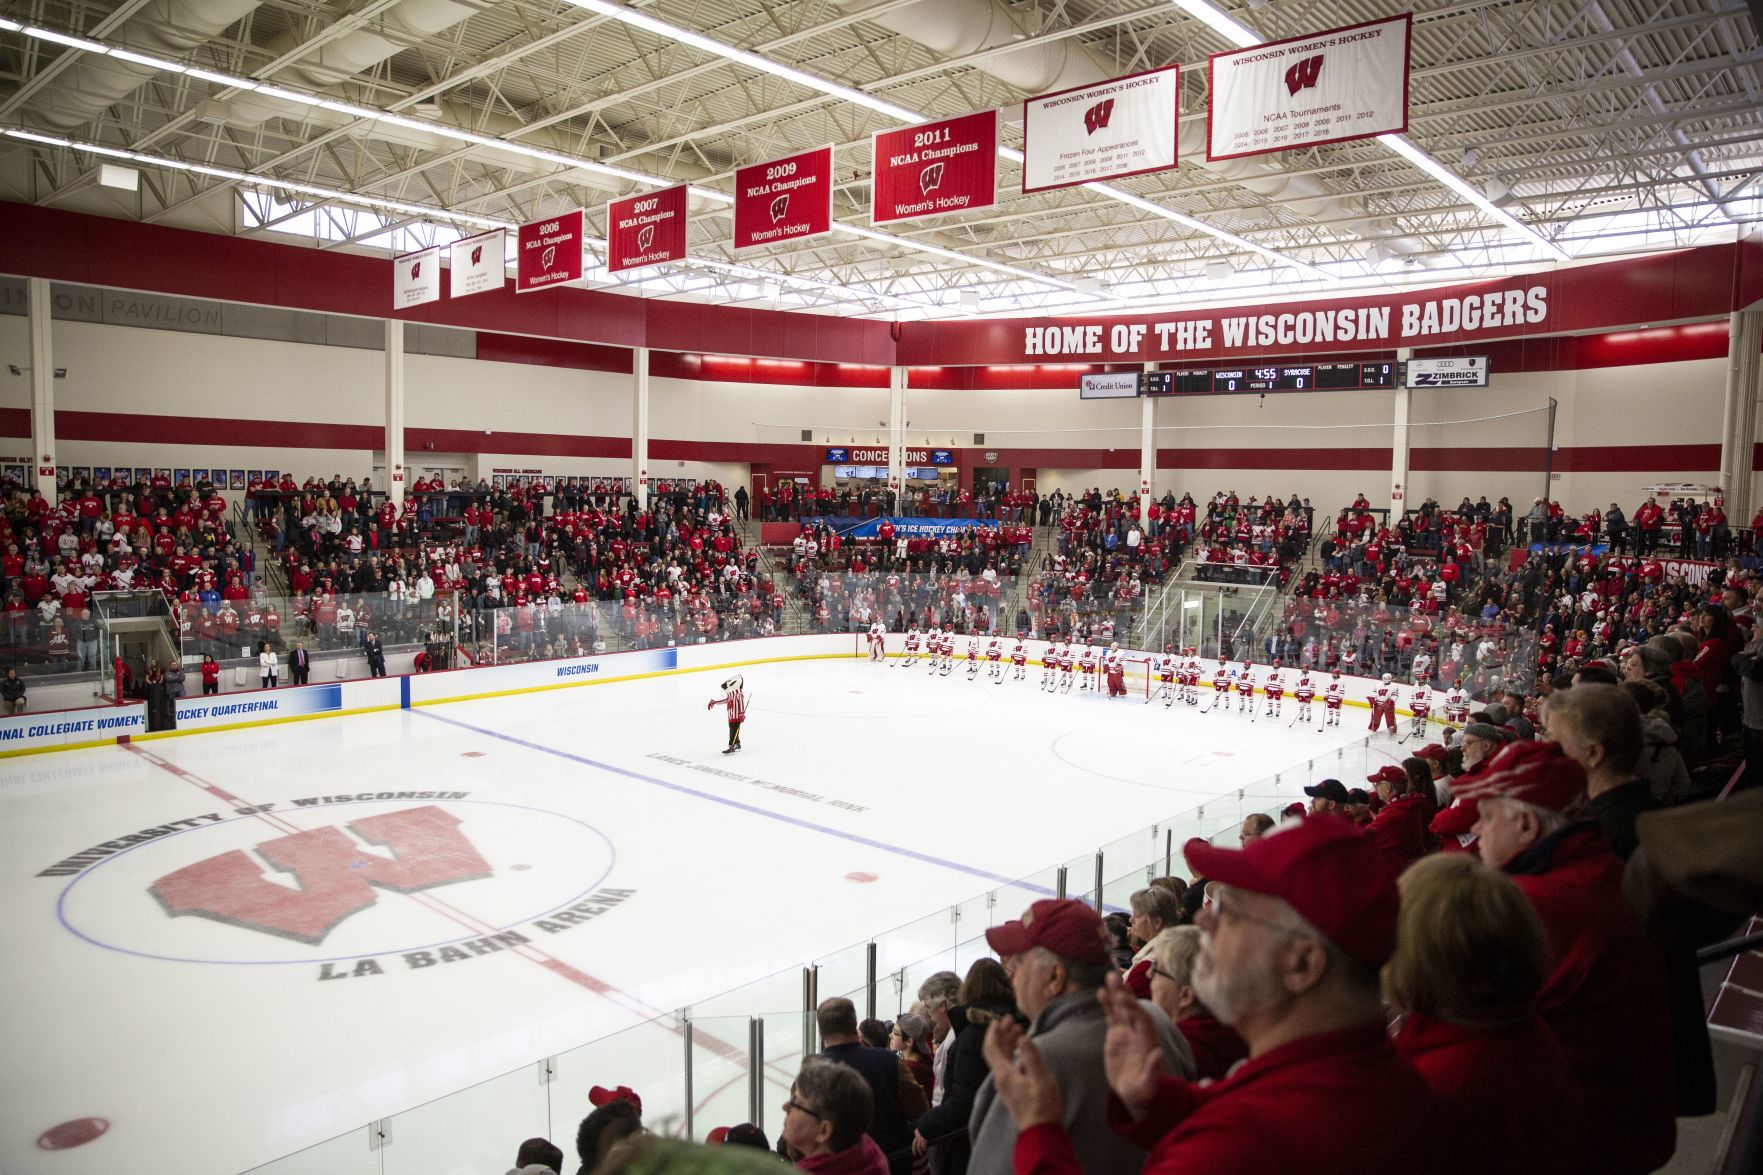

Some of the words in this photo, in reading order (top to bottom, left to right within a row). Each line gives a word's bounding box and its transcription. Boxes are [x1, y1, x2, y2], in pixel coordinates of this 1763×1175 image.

[1232, 48, 1286, 67] WISCONSIN
[1287, 38, 1337, 55] WOMEN'S
[1338, 28, 1383, 45] HOCKEY
[1042, 93, 1085, 109] WISCONSIN
[1086, 83, 1124, 99] WOMEN'S
[1125, 75, 1160, 90] HOCKEY
[1263, 111, 1287, 123] NCAA
[1289, 103, 1342, 119] Tournaments
[1253, 127, 1269, 136] 2006
[1273, 124, 1289, 133] 2007
[1293, 121, 1310, 130] 2008
[1314, 118, 1331, 127] 2009
[1335, 114, 1352, 123] 2011
[1356, 111, 1374, 120] 2012
[914, 127, 951, 148] 2011
[1293, 131, 1309, 140] 2017
[1313, 128, 1330, 138] 2018
[889, 152, 920, 167] NCAA
[921, 142, 979, 161] Champions
[1059, 149, 1081, 160] Frozen
[1081, 147, 1096, 157] Four
[1097, 139, 1139, 155] Appearances
[1132, 149, 1146, 158] 2012
[766, 162, 797, 180] 2009
[746, 184, 771, 198] NCAA
[771, 175, 817, 192] Champions
[633, 198, 659, 214] 2007
[895, 200, 934, 215] Women's
[936, 195, 970, 208] Hockey
[539, 221, 560, 236] 2006
[619, 217, 638, 230] NCAA
[638, 210, 675, 223] Champions
[526, 239, 542, 250] NCAA
[543, 232, 573, 246] Champions
[751, 227, 783, 242] Women's
[783, 223, 811, 236] Hockey
[622, 254, 648, 267] Women's
[648, 250, 670, 261] Hockey
[529, 273, 551, 285] Women's
[551, 270, 569, 280] Hockey
[111, 299, 219, 326] PAVILION
[1025, 325, 1103, 355] HOME
[1110, 324, 1147, 353] OF
[1154, 319, 1213, 351] THE
[1221, 306, 1391, 348] WISCONSIN
[1401, 286, 1547, 338] BADGERS
[1215, 371, 1243, 379] WISCONSIN
[1255, 368, 1277, 379] 4:55
[1283, 367, 1311, 376] SYRACUSE
[1382, 365, 1389, 374] 0
[1432, 371, 1479, 380] ZIMBRICK
[1095, 382, 1113, 391] Credit
[1114, 381, 1133, 390] Union
[1228, 380, 1236, 391] 0
[1296, 377, 1304, 388] 0
[852, 450, 927, 463] CONCEONS
[907, 525, 919, 533] ICE
[919, 525, 946, 535] HOCKEY
[557, 663, 600, 677] WISCONSIN
[211, 699, 279, 717] QUARTERFINAL
[28, 719, 95, 738] COLLEGIATE
[34, 812, 226, 879] UNIVERSITY
[233, 802, 275, 817] OF
[291, 791, 472, 809] WISCONSIN
[317, 958, 384, 982] LA
[401, 929, 533, 970] BAHN
[532, 886, 638, 935] ARENA
